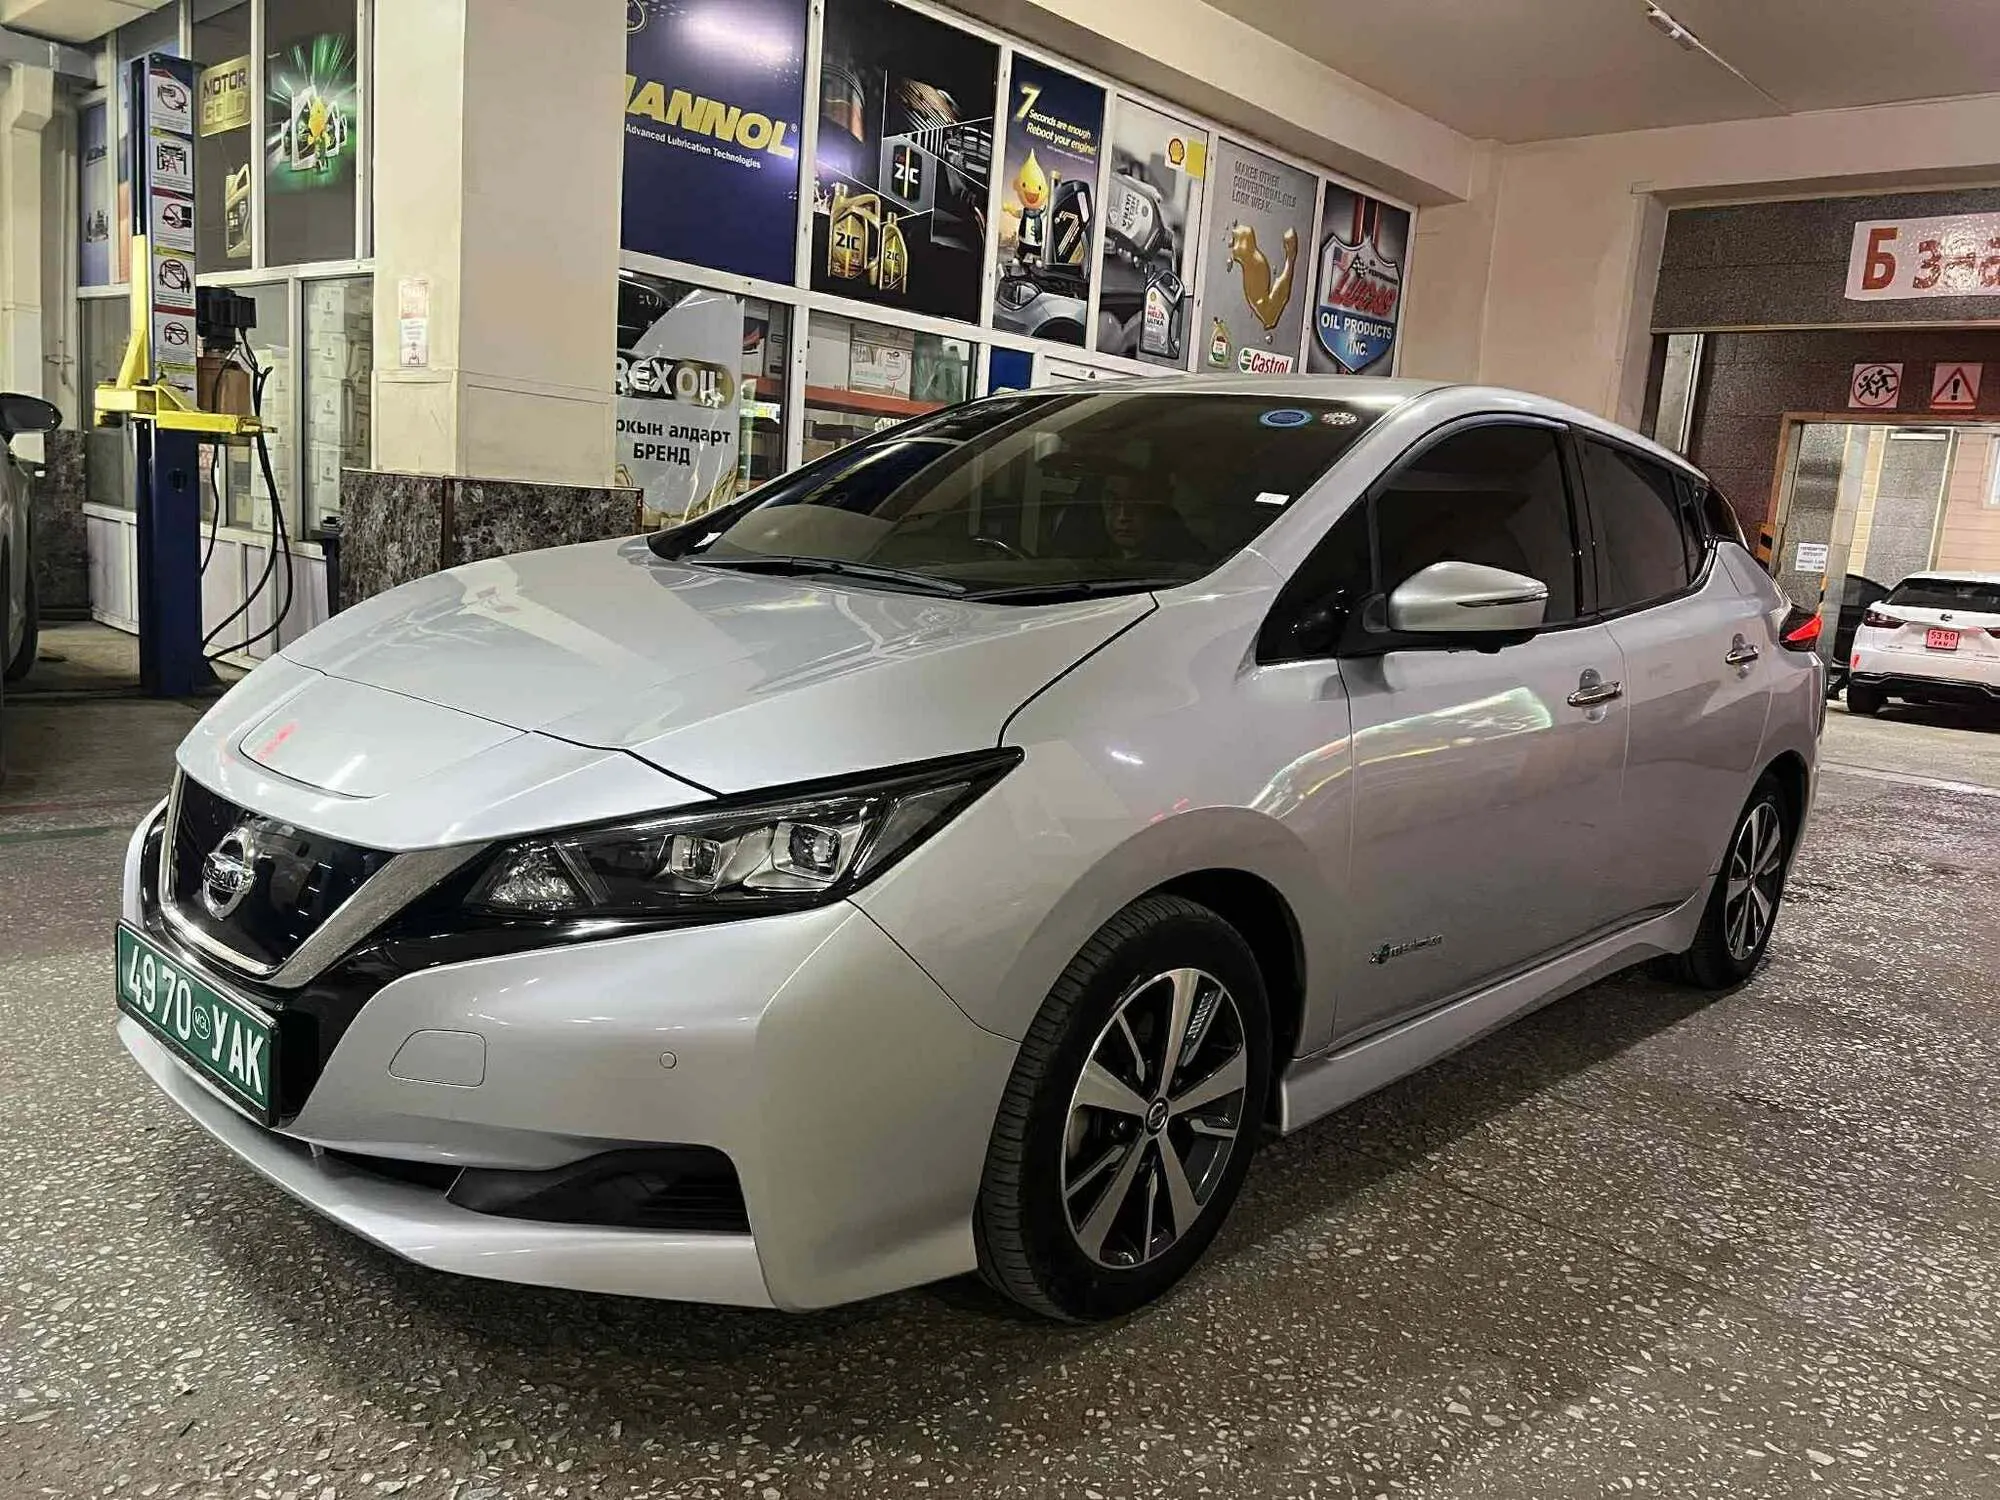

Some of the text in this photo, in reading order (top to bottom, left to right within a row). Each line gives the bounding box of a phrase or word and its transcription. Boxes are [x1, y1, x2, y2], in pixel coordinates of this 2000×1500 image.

[203, 68, 247, 98] MOTOR
[203, 91, 246, 125] GOLD
[1016, 85, 1091, 140] 7 Seconds are enough
[626, 123, 761, 169] Advanced Lubrication Technologies
[1026, 122, 1054, 140] Reboot
[1053, 133, 1071, 147] your
[894, 153, 919, 192] ZIC
[835, 231, 860, 252] ZIC
[886, 249, 900, 262] ZIC
[1862, 227, 1898, 290] Б
[1320, 311, 1393, 340] OIL PRODUCTS
[1347, 340, 1369, 356] INC.
[1251, 353, 1290, 374] Castrol
[669, 425, 731, 447] алдарт
[633, 442, 691, 466] БРЕНД
[210, 1003, 265, 1096] УАК
